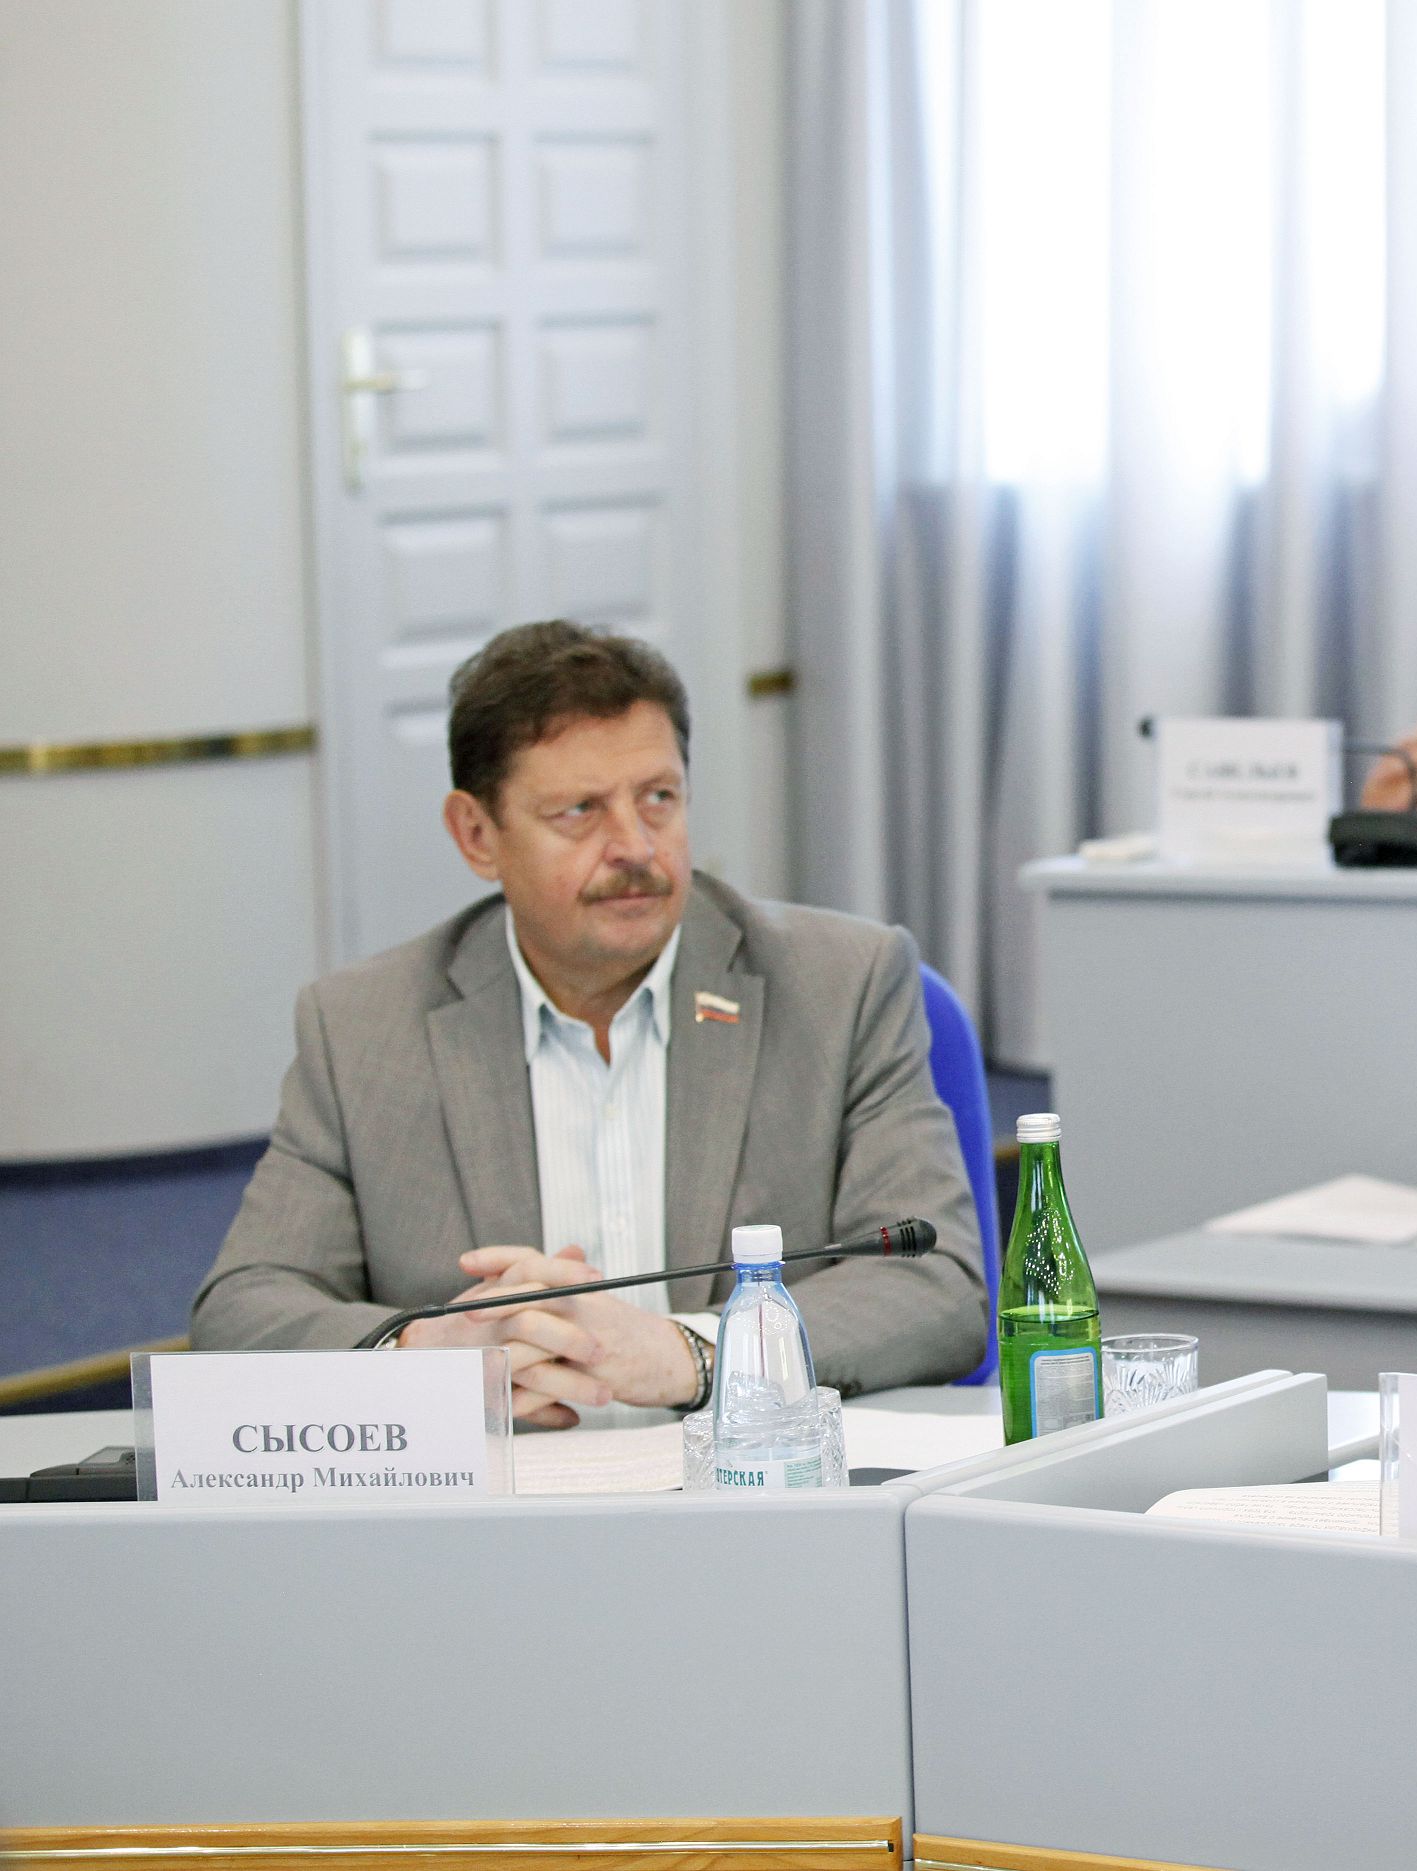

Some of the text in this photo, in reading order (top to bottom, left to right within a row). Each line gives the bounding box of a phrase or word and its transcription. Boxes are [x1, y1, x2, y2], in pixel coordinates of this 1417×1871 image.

[232, 1423, 408, 1453] СЫСОЕВ
[170, 1467, 475, 1493] Александр Михайлович
